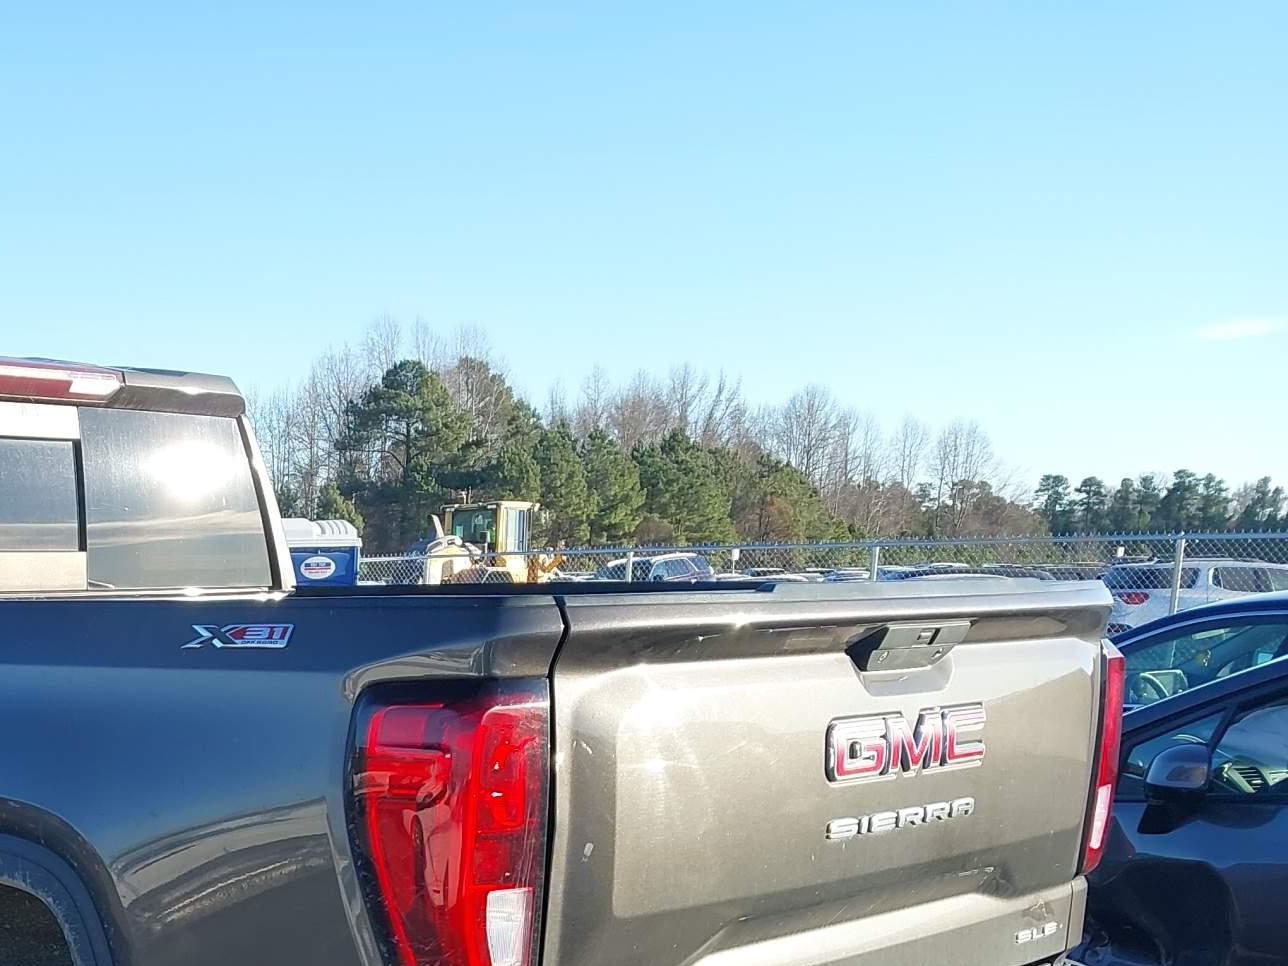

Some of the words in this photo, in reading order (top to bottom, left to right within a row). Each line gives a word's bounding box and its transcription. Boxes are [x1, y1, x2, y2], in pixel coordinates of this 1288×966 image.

[825, 702, 986, 786] GMC
[825, 797, 975, 840] SIERRA
[1015, 922, 1058, 944] SLE
